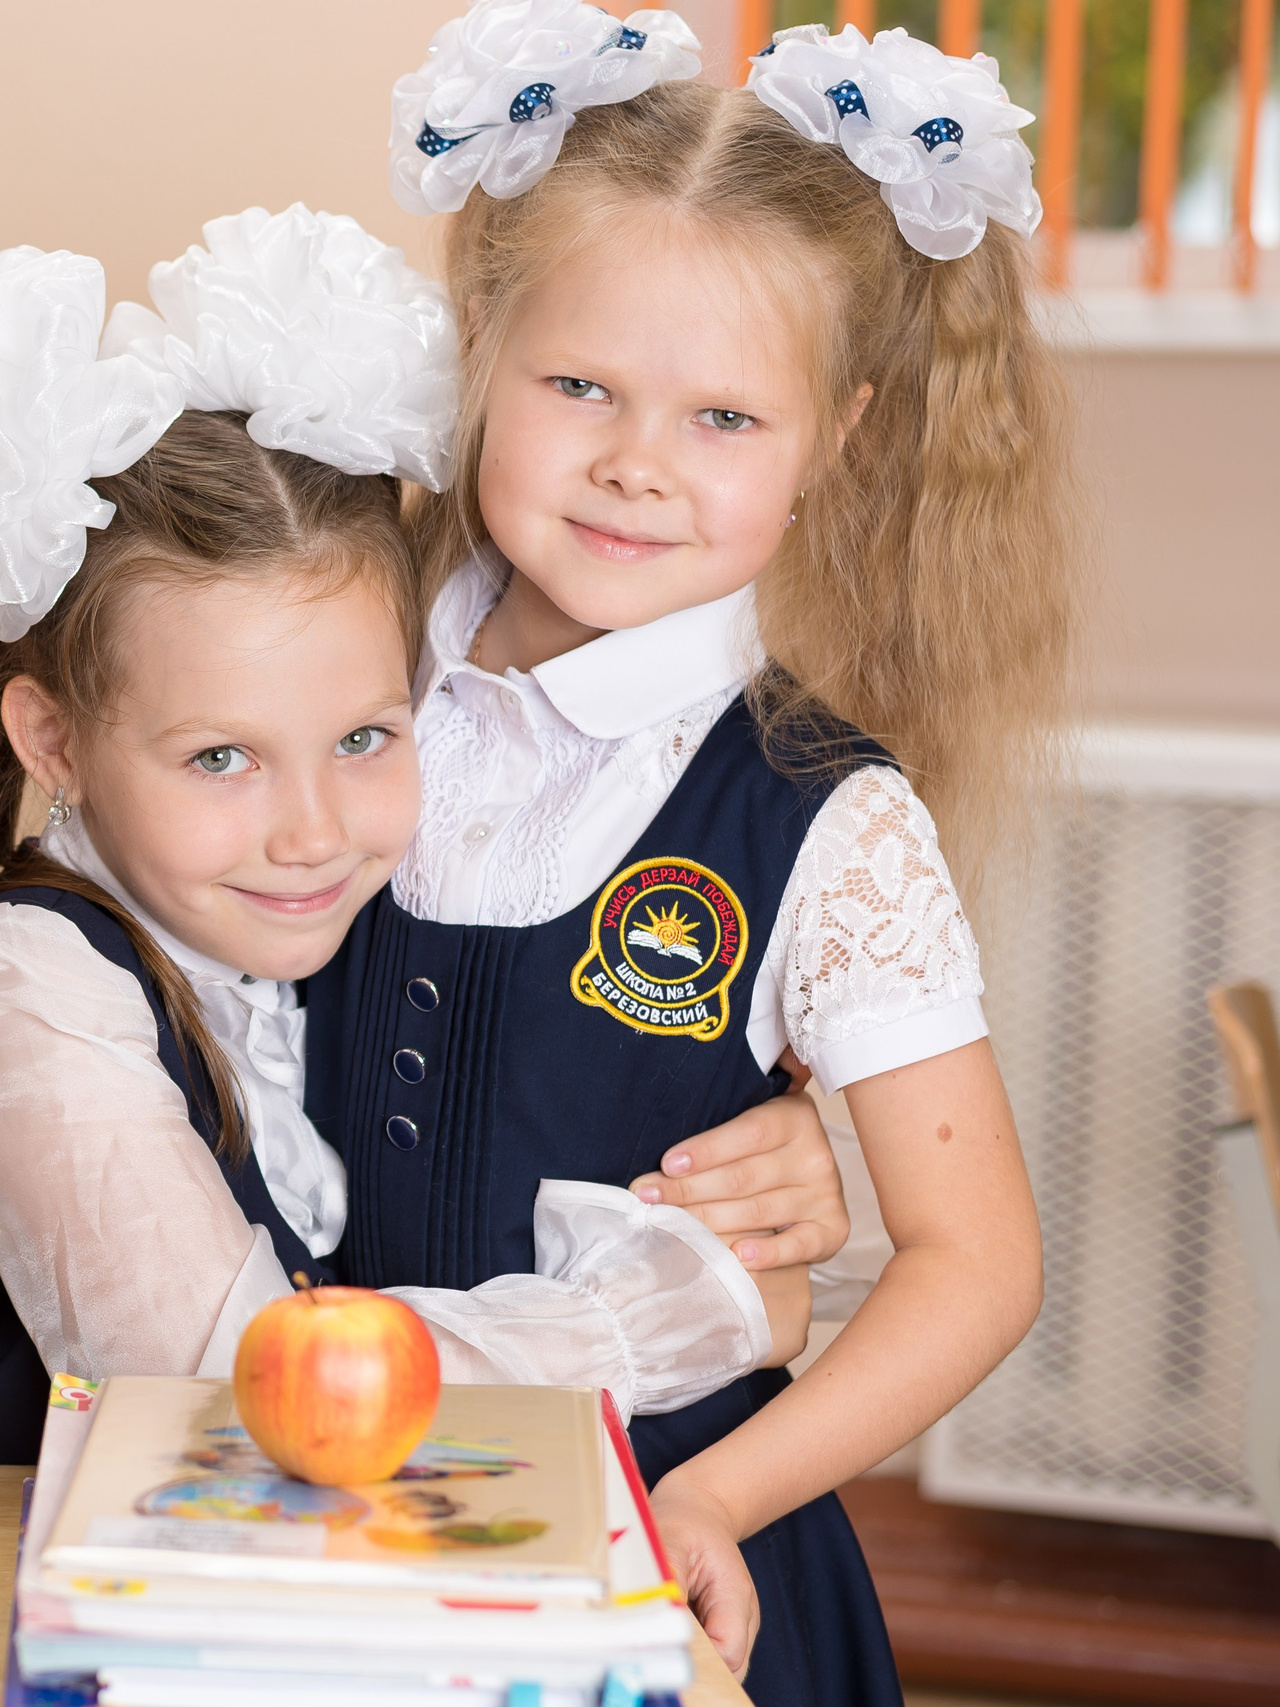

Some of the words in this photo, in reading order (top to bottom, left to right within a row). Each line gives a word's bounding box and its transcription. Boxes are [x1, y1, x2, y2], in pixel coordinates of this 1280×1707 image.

[603, 884, 637, 928] УЧИСЬ
[640, 868, 701, 889] ДЕРЗАЙ
[702, 882, 738, 966] ПОБЕЖДАЙ
[591, 972, 709, 1025] БЕРЕЗОВСКИЙ
[615, 961, 664, 1001] ШКОЛА
